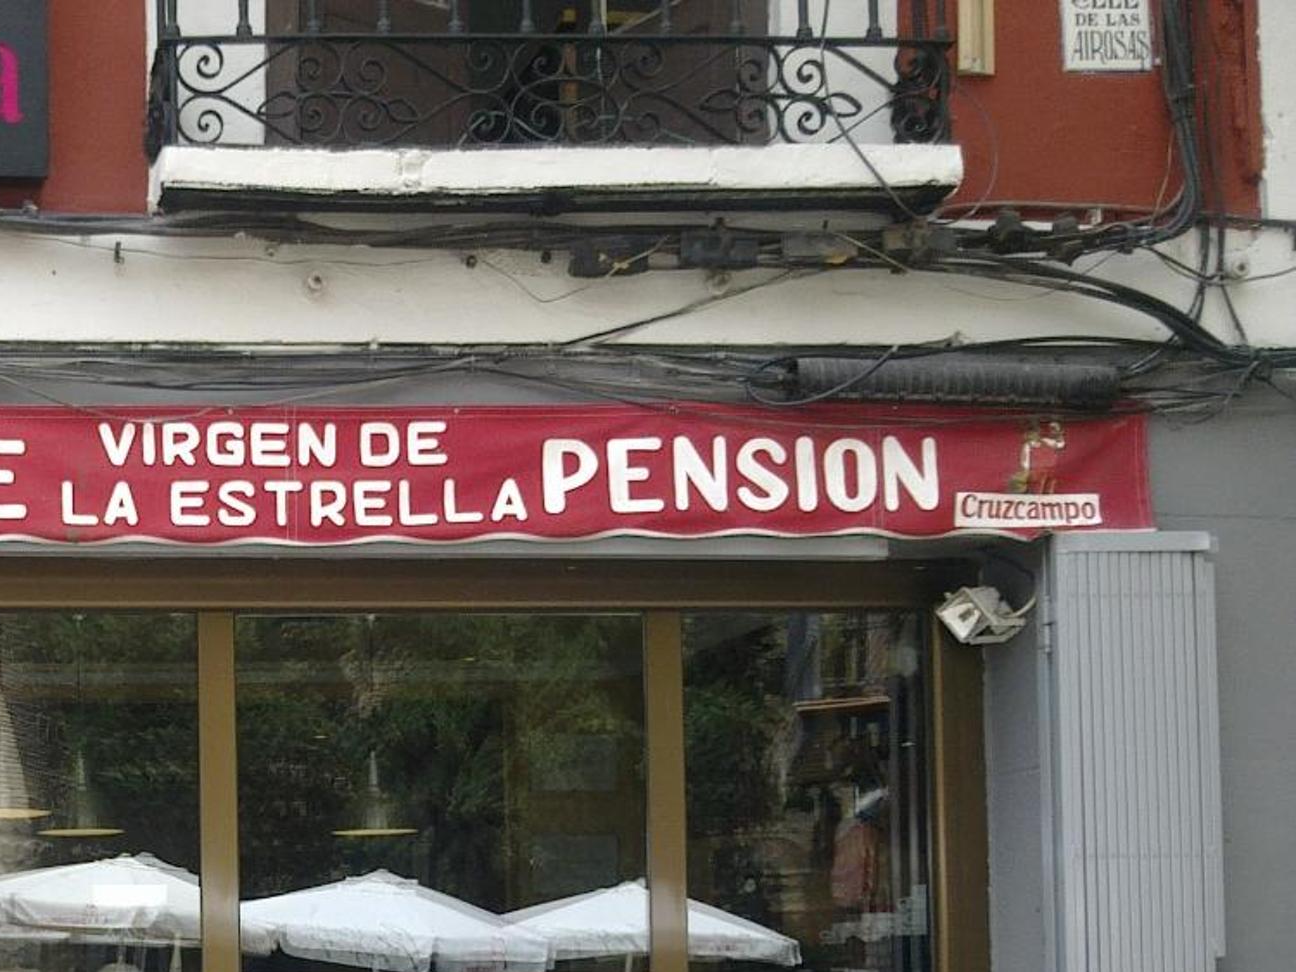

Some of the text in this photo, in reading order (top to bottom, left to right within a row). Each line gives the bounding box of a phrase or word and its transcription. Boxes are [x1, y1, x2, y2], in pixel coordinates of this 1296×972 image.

[1075, 13, 1140, 27] DE LAS
[1072, 30, 1149, 64] AIROSAS
[97, 420, 449, 467] VIRGEN DE
[542, 434, 941, 513] PENSION
[60, 477, 528, 527] LA ESTRELLA
[961, 494, 1098, 524] Cruzcampo
